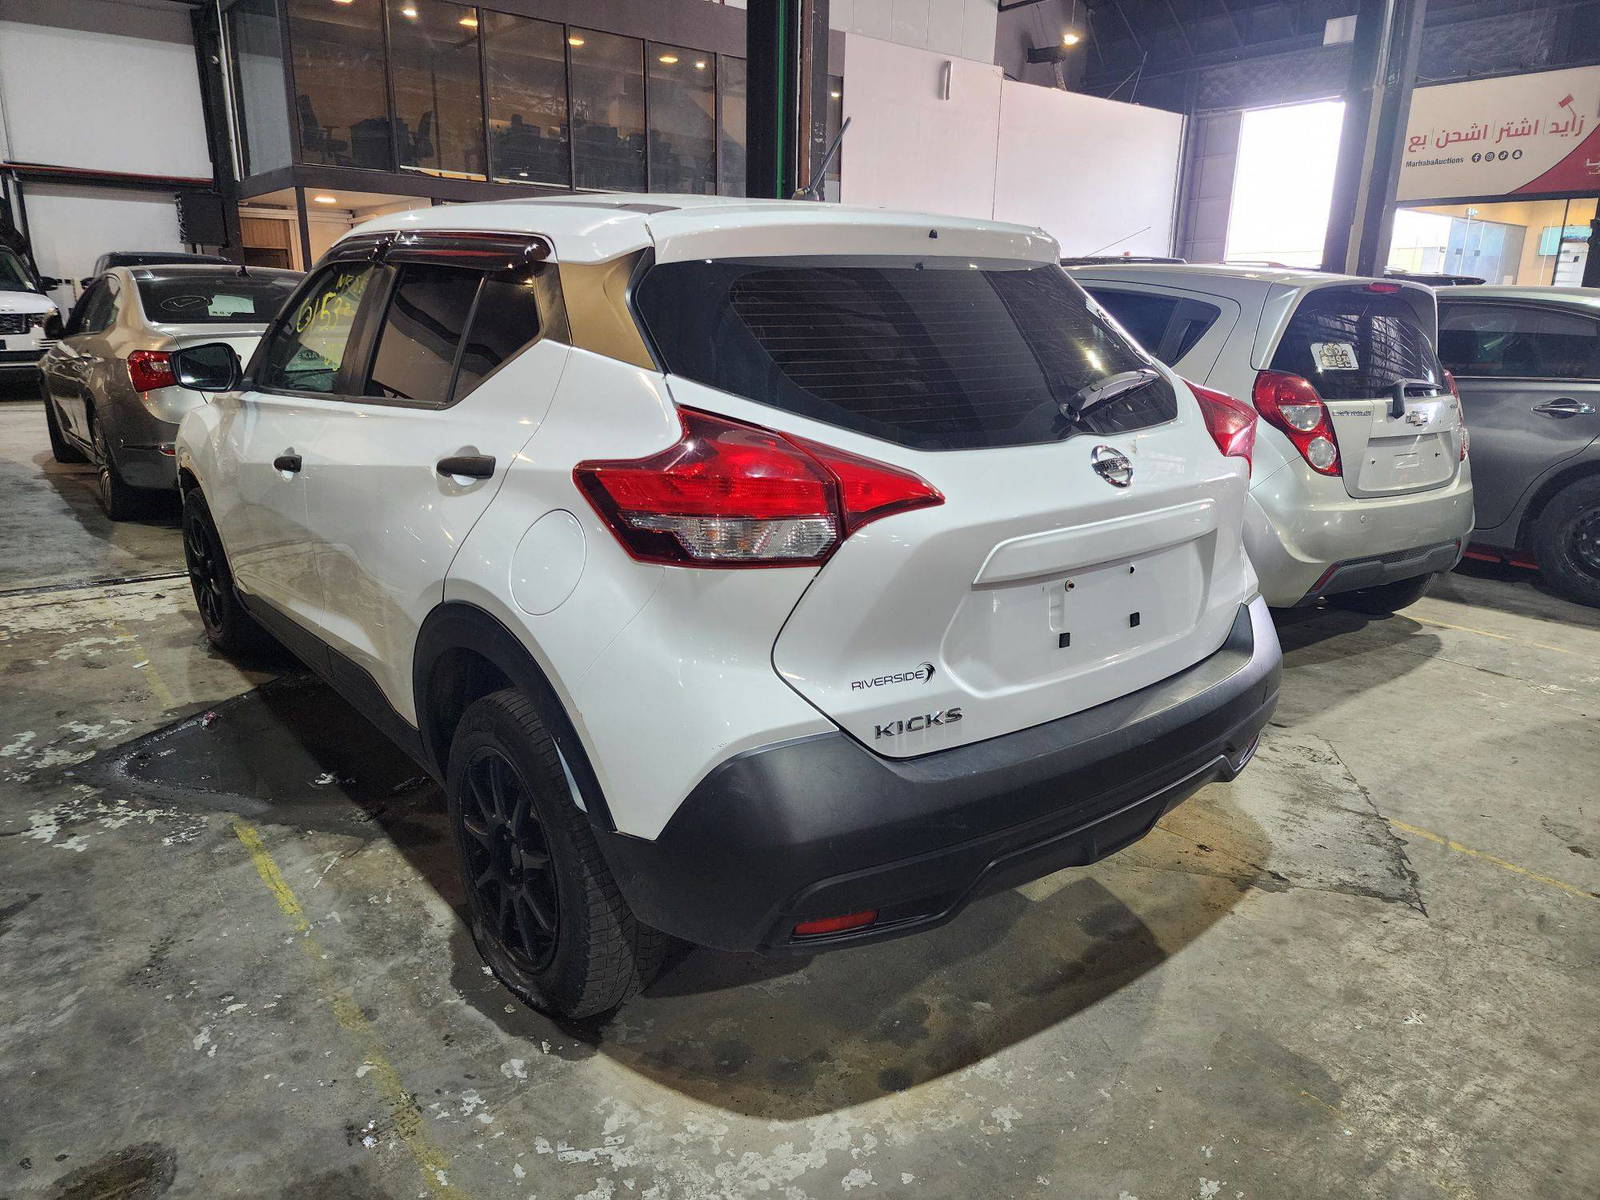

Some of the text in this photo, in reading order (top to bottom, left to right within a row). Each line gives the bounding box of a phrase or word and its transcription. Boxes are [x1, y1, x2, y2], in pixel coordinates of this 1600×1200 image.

[1408, 113, 1585, 153] زايد اشتر اشحن بع
[1405, 156, 1465, 168] MarhabaAuctions
[851, 669, 925, 692] RIVERSIDE
[874, 707, 963, 740] KICKS
